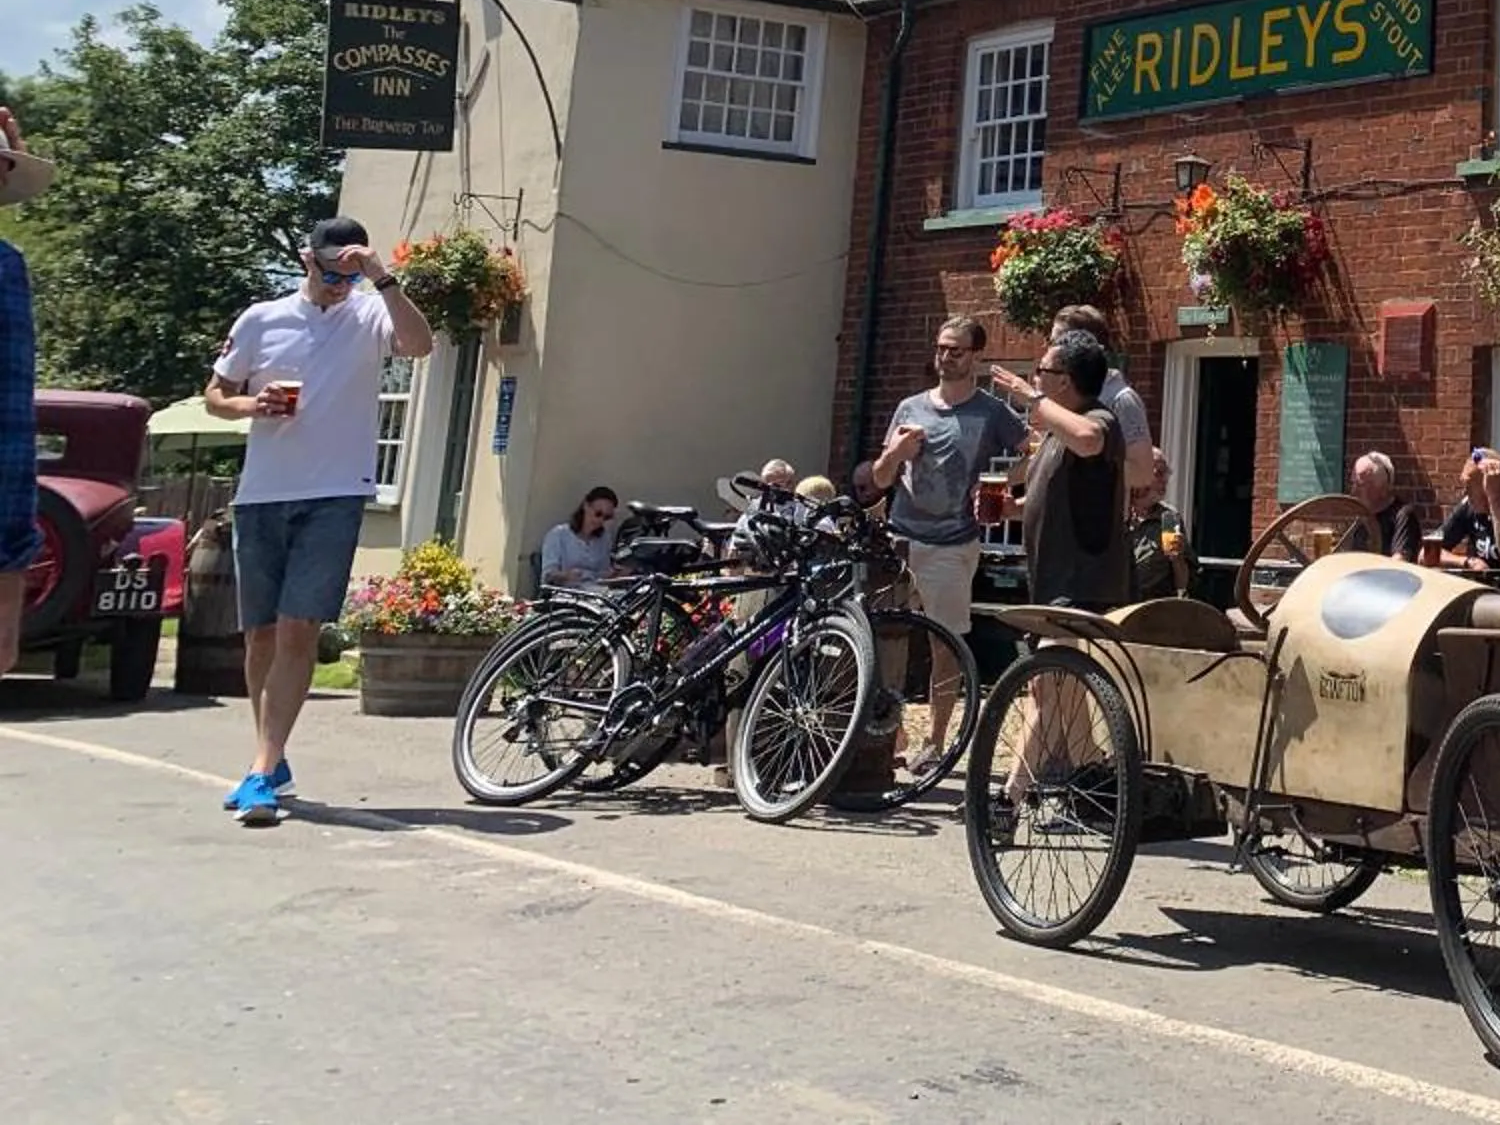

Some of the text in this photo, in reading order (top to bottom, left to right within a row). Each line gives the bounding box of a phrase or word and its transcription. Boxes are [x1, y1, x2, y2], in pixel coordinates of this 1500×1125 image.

[343, 2, 447, 24] RIDLEYS
[383, 25, 406, 40] The
[1369, 1, 1424, 76] STOUT
[333, 44, 450, 78] COMPASSES
[1091, 29, 1126, 83] FINE
[373, 76, 411, 96] INN
[1096, 54, 1132, 112] ALES
[115, 572, 149, 590] DS
[98, 591, 157, 610] 8110
